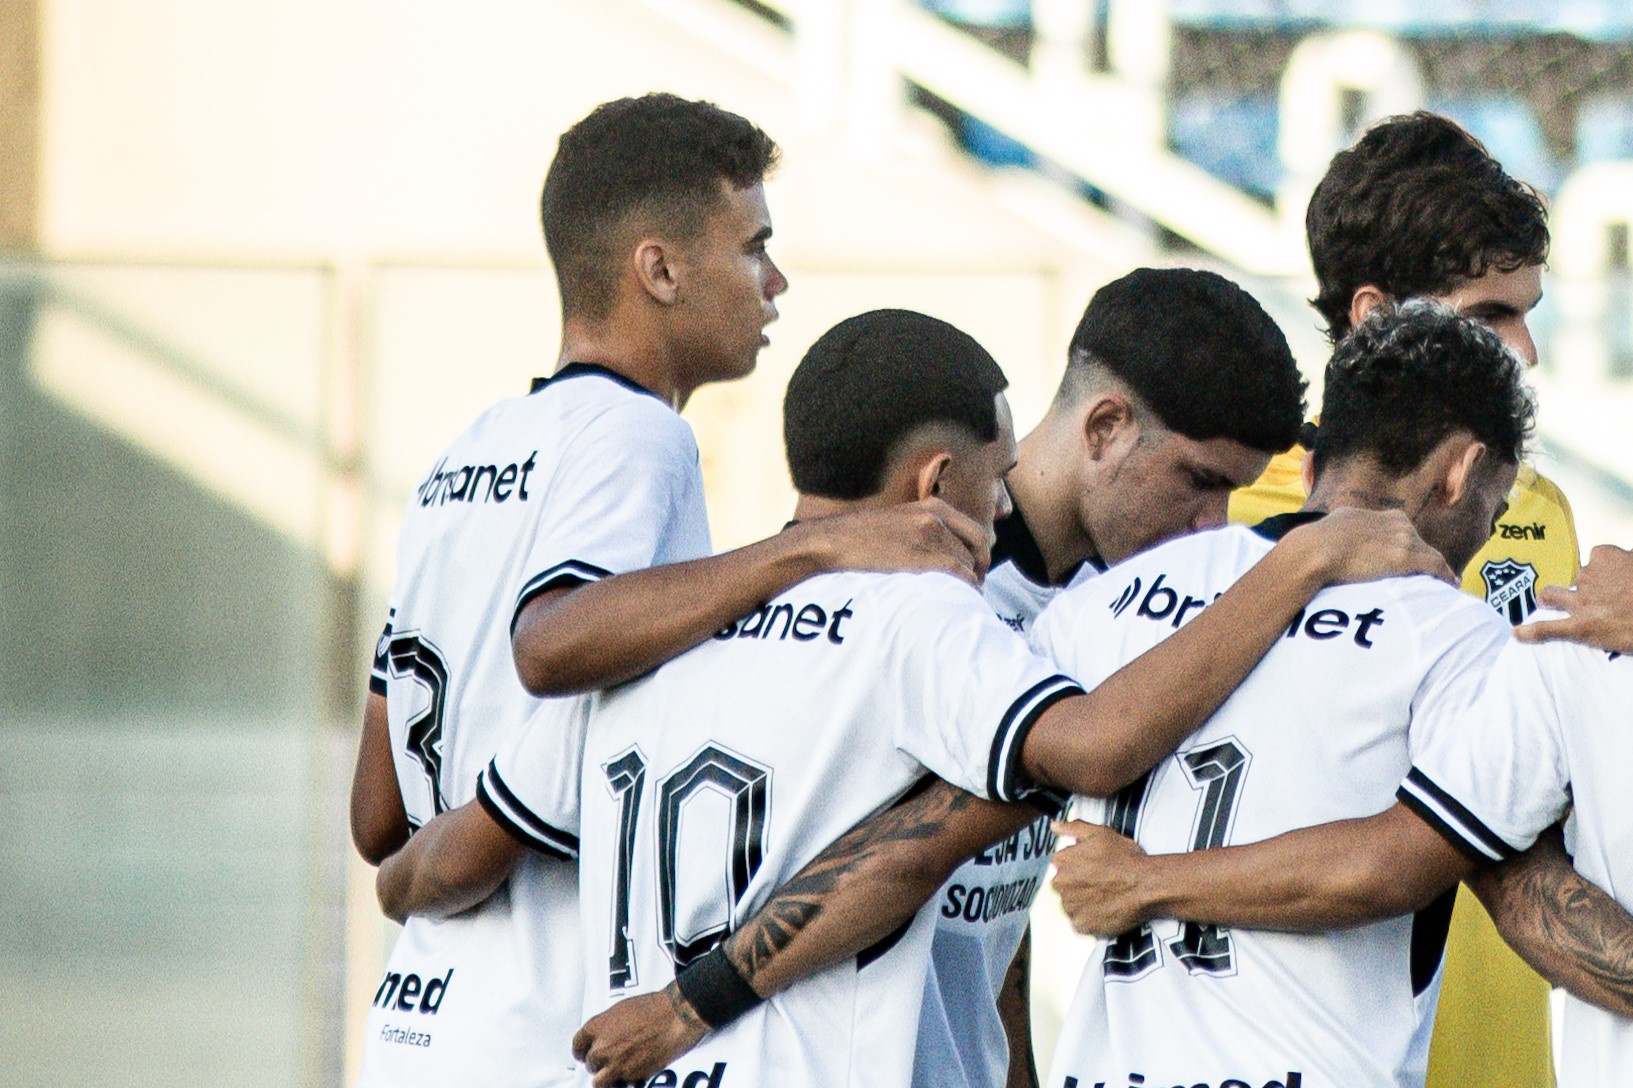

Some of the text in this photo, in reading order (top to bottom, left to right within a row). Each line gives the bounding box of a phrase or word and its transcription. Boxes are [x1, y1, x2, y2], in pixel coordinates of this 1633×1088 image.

[1498, 522, 1547, 541] zenir
[599, 738, 775, 998] 10
[380, 1023, 432, 1048] Fortaleza
